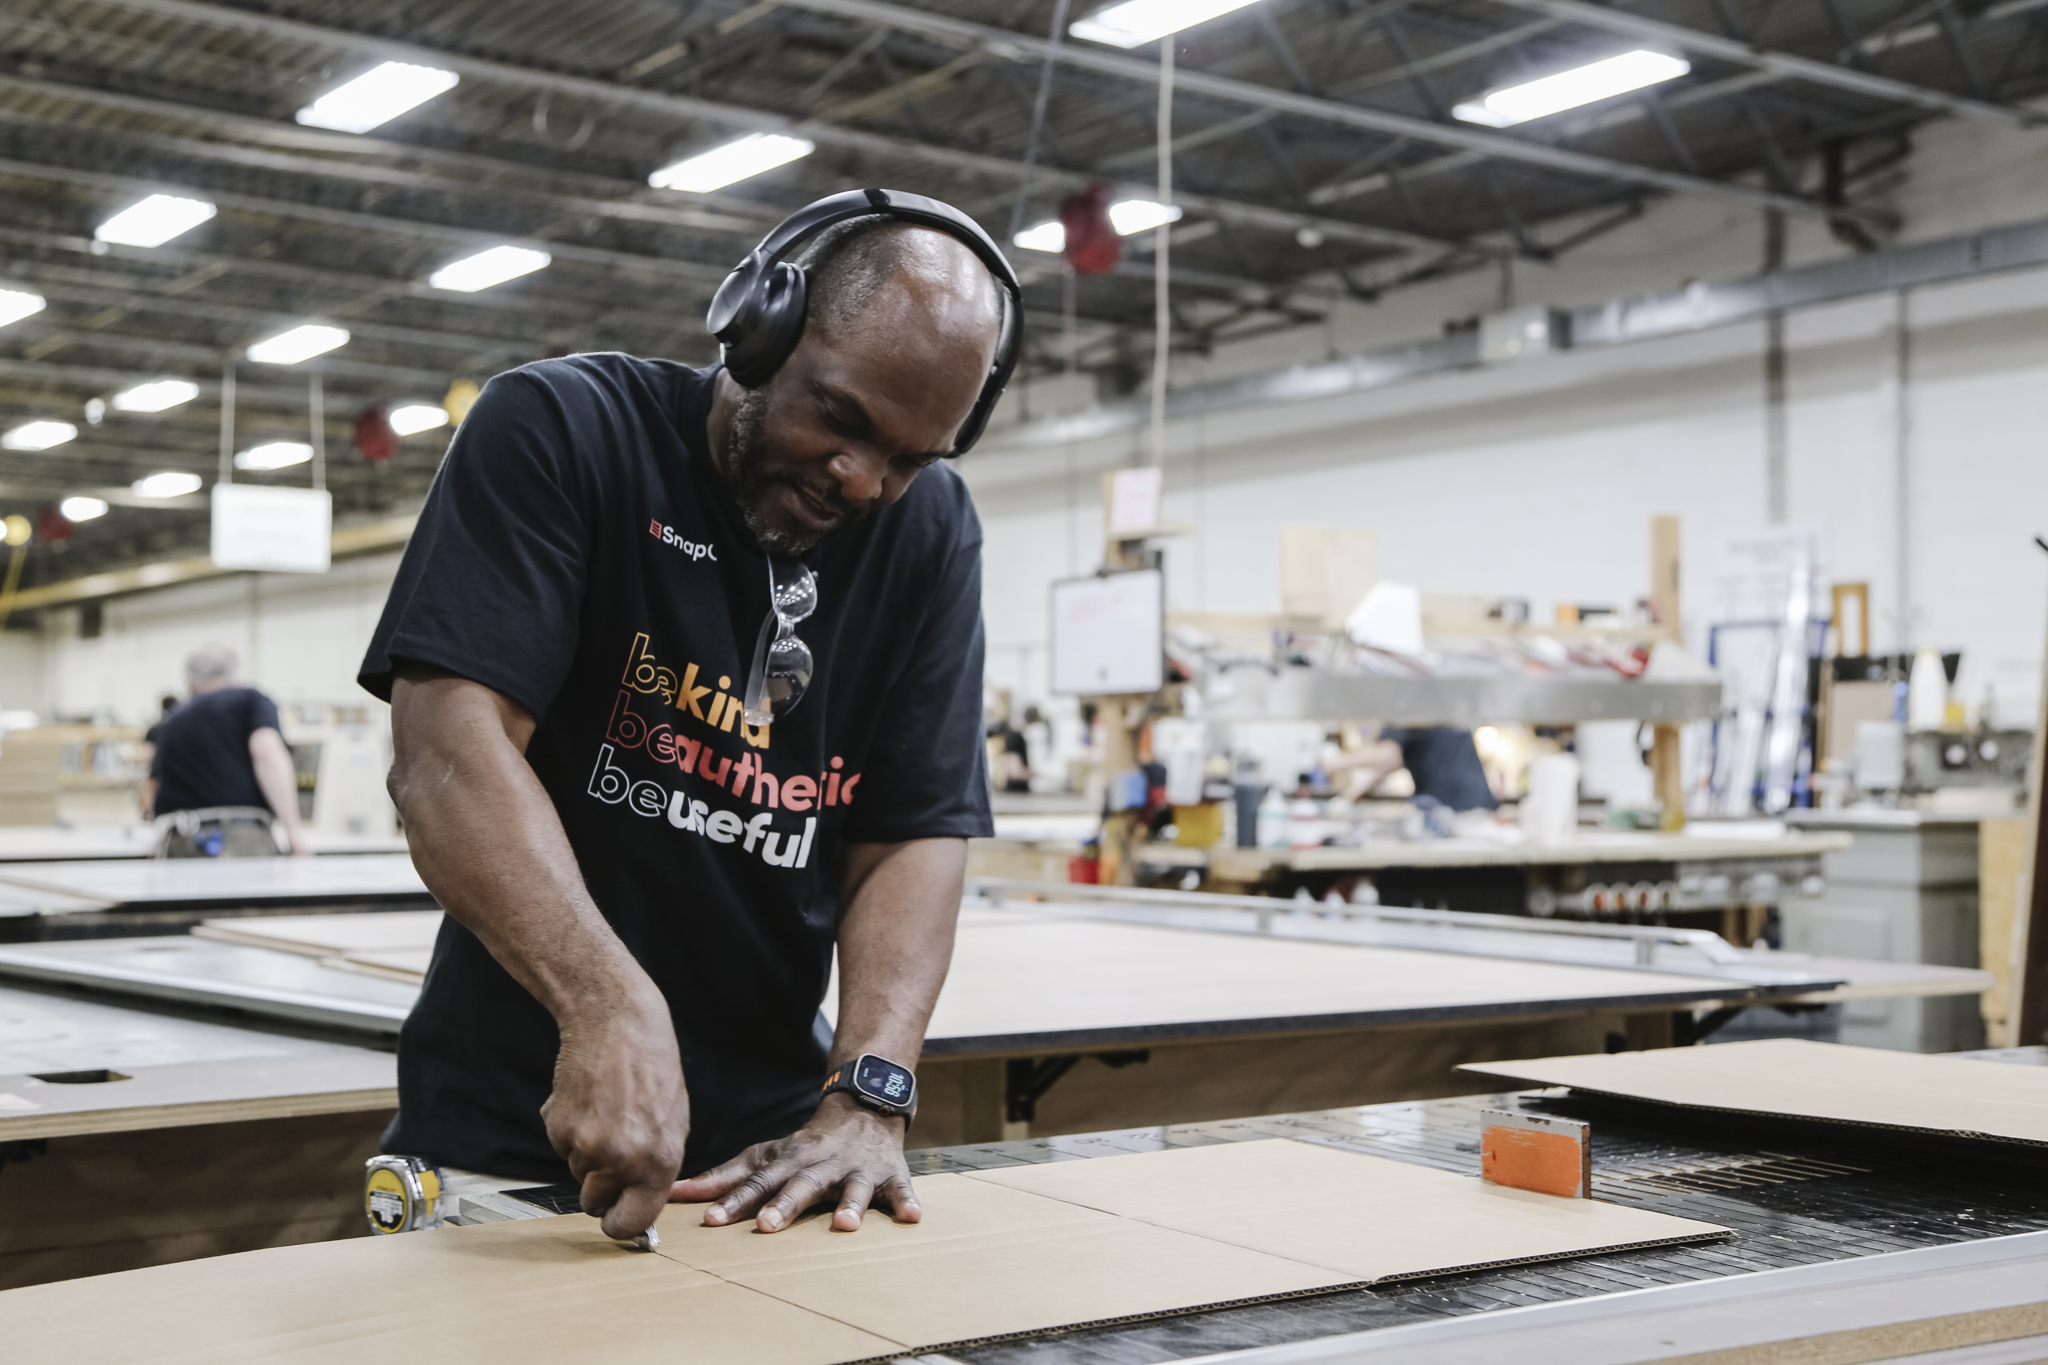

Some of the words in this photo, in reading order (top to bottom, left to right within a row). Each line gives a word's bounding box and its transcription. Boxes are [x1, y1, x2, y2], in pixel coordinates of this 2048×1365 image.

[606, 689, 677, 763] be
[674, 733, 861, 812] autheic
[622, 632, 678, 705] be
[676, 662, 771, 749] kind
[587, 743, 668, 817] be
[667, 790, 817, 868] useful
